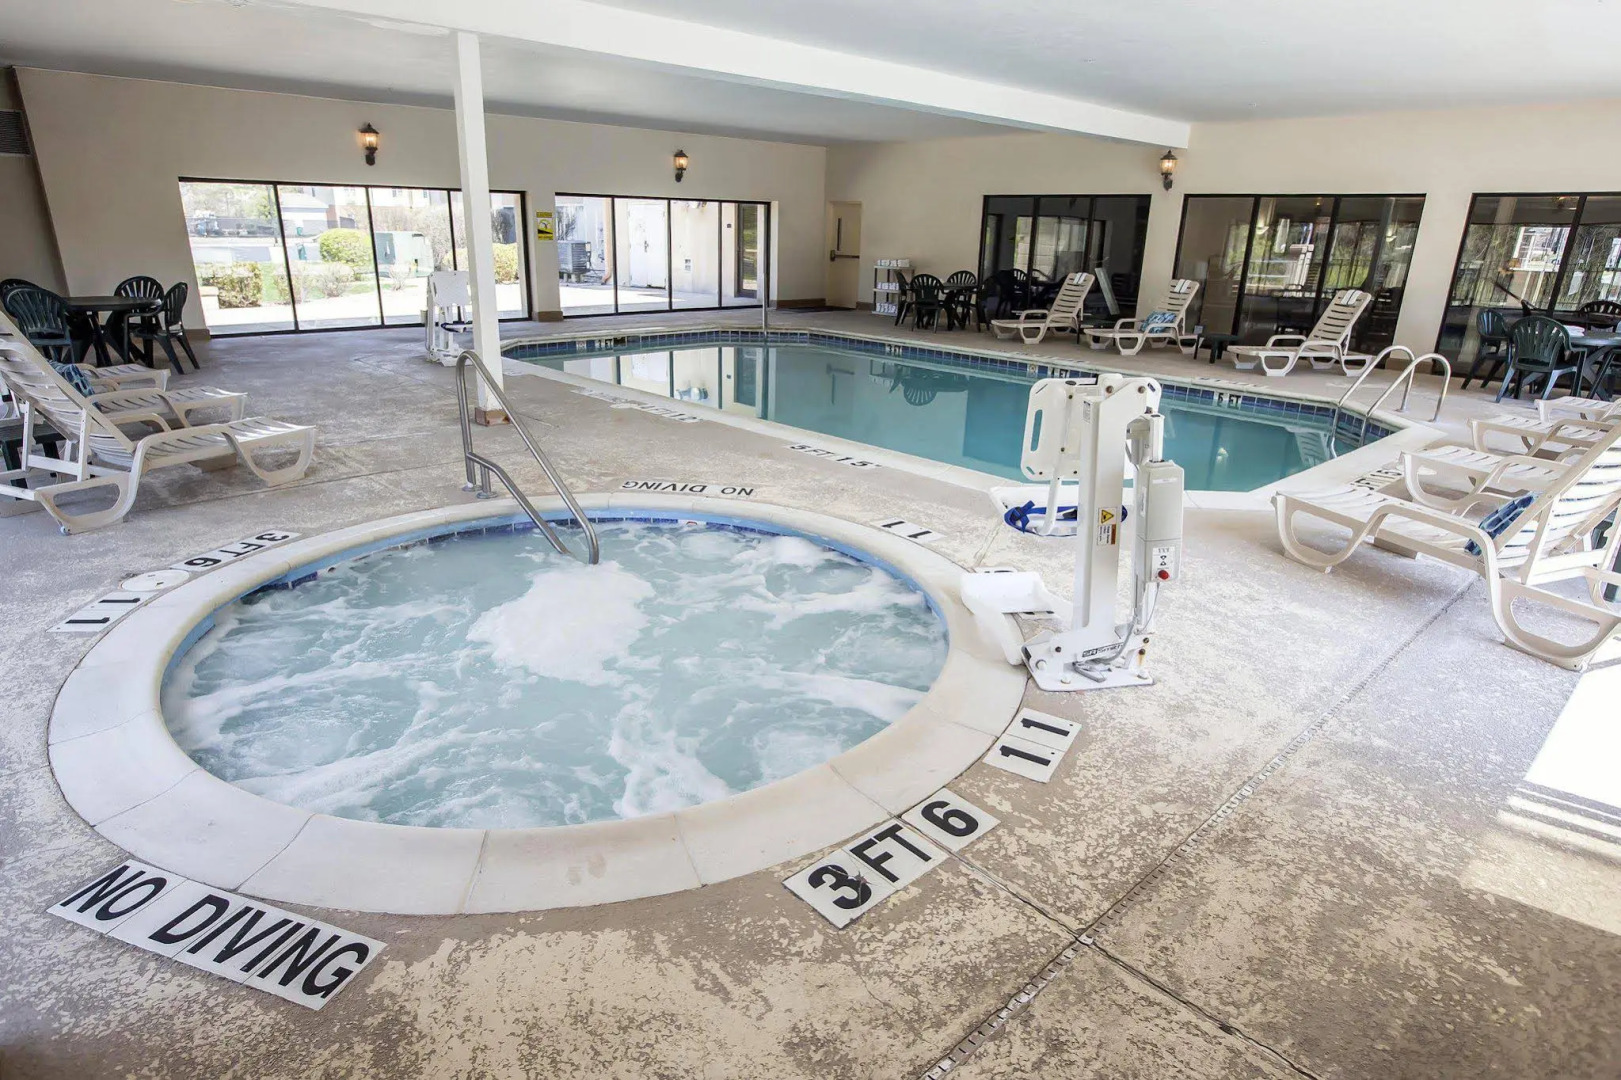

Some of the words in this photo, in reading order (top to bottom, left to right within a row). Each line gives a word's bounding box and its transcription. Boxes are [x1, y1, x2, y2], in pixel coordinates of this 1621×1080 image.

[622, 481, 708, 493] DIVING
[721, 486, 755, 496] NO
[255, 533, 290, 542] 3
[218, 542, 266, 558] FT
[807, 864, 873, 910] 3
[849, 823, 933, 884] FT
[920, 800, 980, 838] 6
[60, 865, 168, 922] NO
[147, 893, 370, 1000] DIVING
